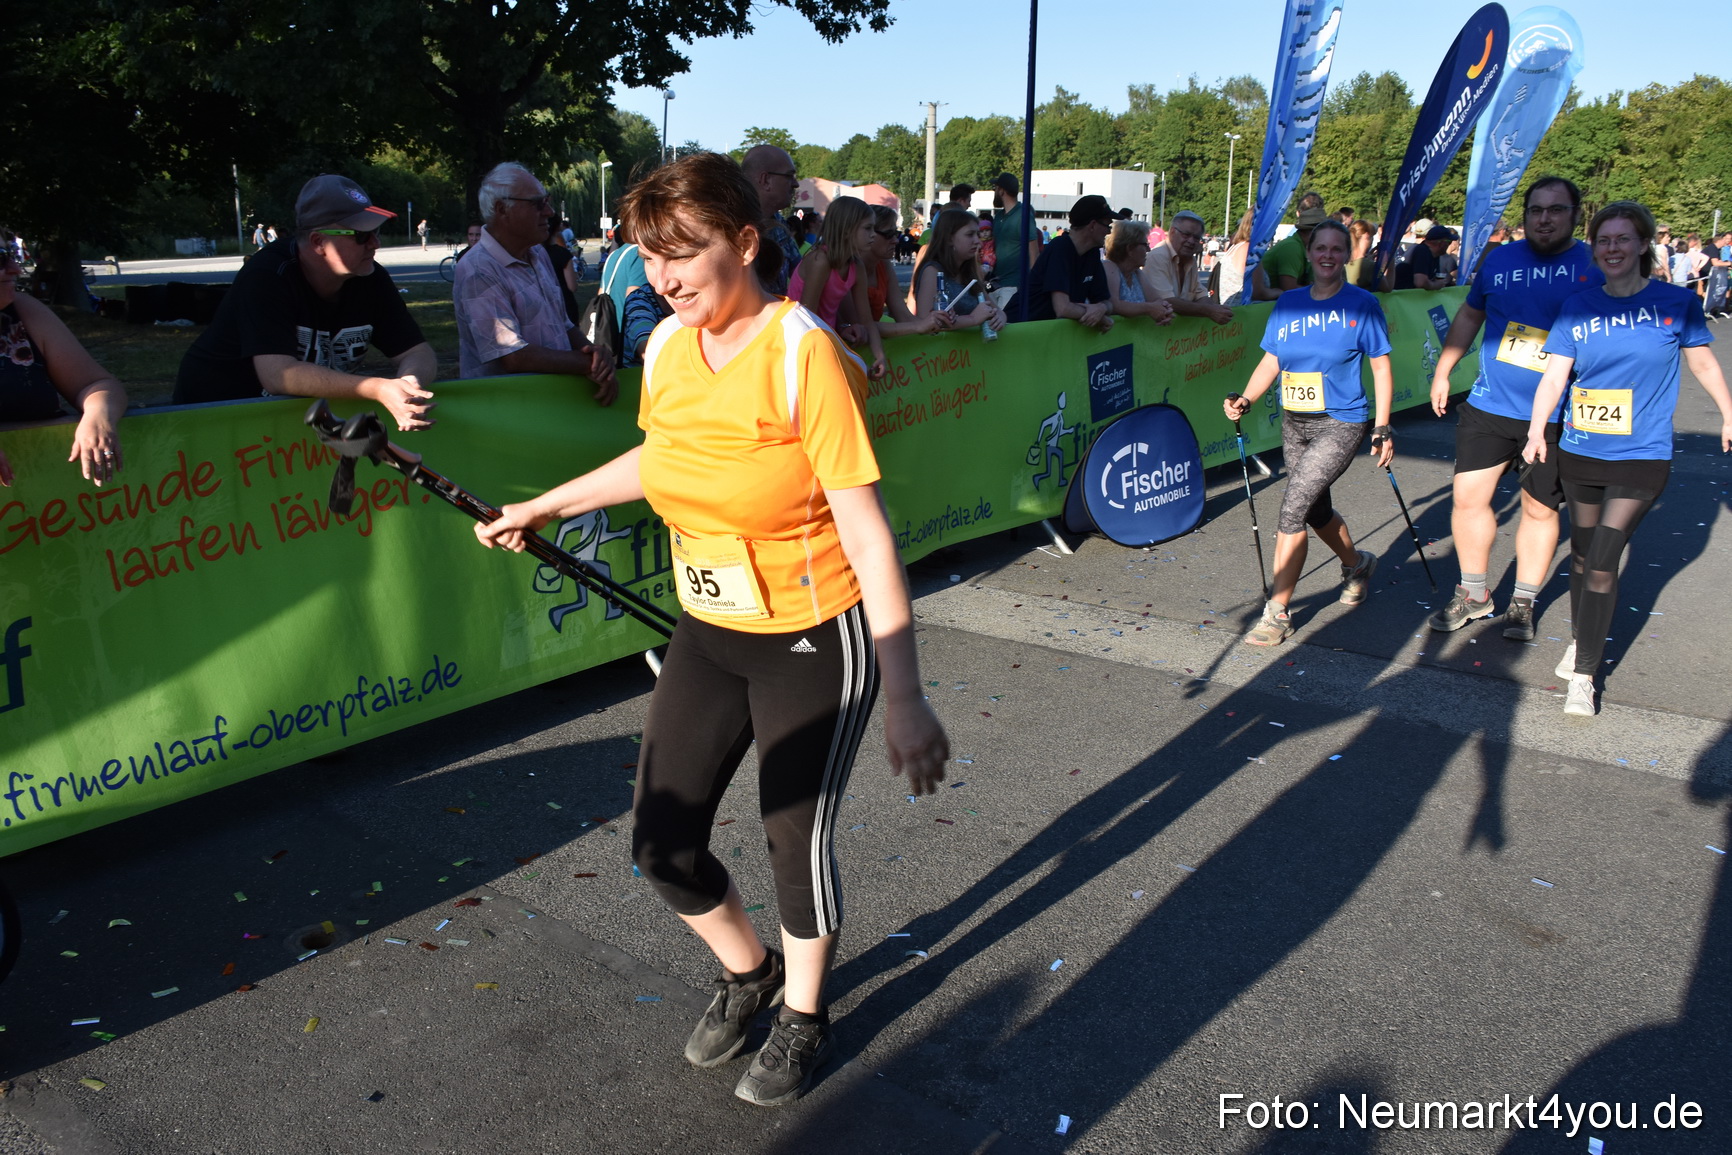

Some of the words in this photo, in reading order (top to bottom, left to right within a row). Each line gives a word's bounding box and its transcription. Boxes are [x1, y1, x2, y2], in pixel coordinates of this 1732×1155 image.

[1441, 121, 1460, 153] Druck
[1458, 101, 1472, 124] und
[1473, 63, 1499, 102] Medien
[1399, 86, 1472, 208] Frischmann
[1165, 325, 1209, 360] Gesunde
[1212, 321, 1244, 344] Firmen
[911, 349, 971, 382] Firmen
[1097, 368, 1127, 386] Fischer
[1184, 353, 1214, 382] laufen
[869, 396, 928, 440] laufen
[930, 370, 988, 419] länger!
[1284, 386, 1316, 400] 1736
[1578, 404, 1622, 421] 1724
[0, 450, 222, 555] Gesunde
[234, 435, 341, 487] Firm
[1121, 460, 1191, 499] Fischer
[1134, 485, 1191, 513] AUTOMOBILE
[106, 516, 263, 594] laufen
[270, 476, 431, 543] länger
[686, 565, 720, 598] 95
[688, 594, 707, 605] Taylor
[707, 598, 736, 607] Daniela
